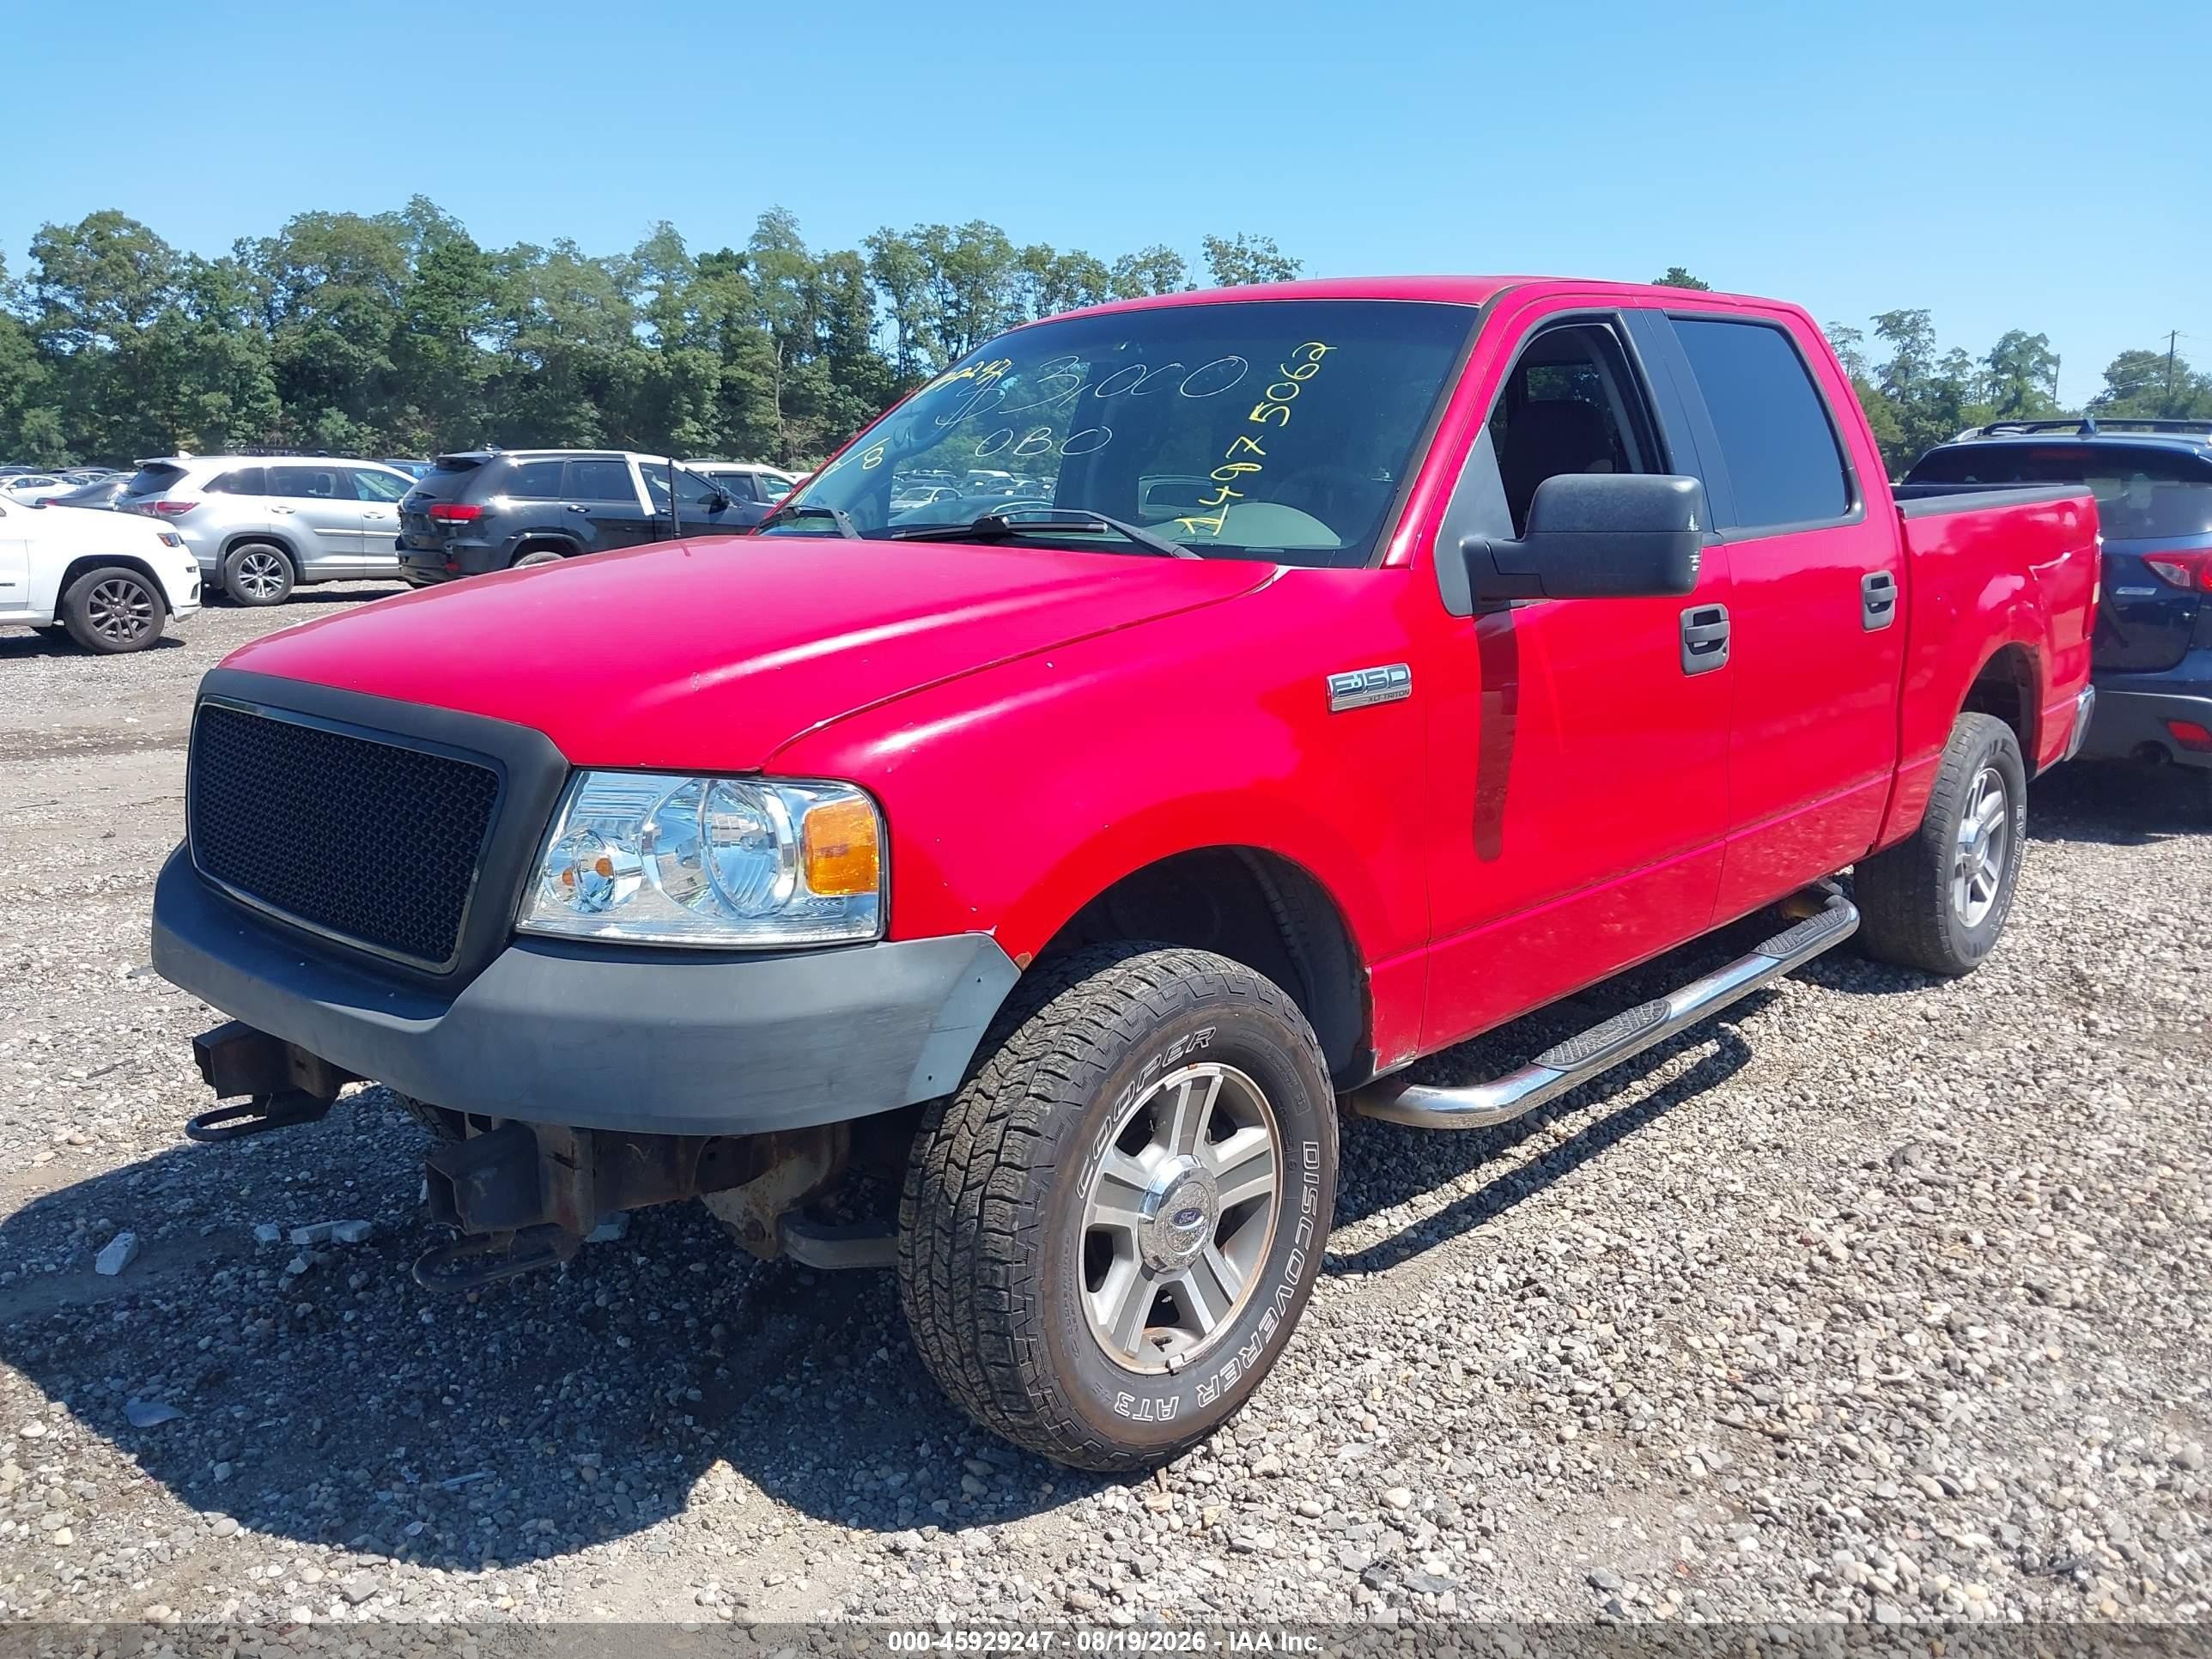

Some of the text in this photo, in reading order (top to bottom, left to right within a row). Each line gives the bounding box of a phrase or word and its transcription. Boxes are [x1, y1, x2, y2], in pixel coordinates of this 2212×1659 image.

[975, 425, 1113, 458] OBO
[1989, 805, 2025, 936] EVOLUTO
[1077, 1026, 1217, 1200] COOPER
[1196, 1140, 1320, 1410] DISCOVERER
[1114, 1391, 1180, 1423] AT3
